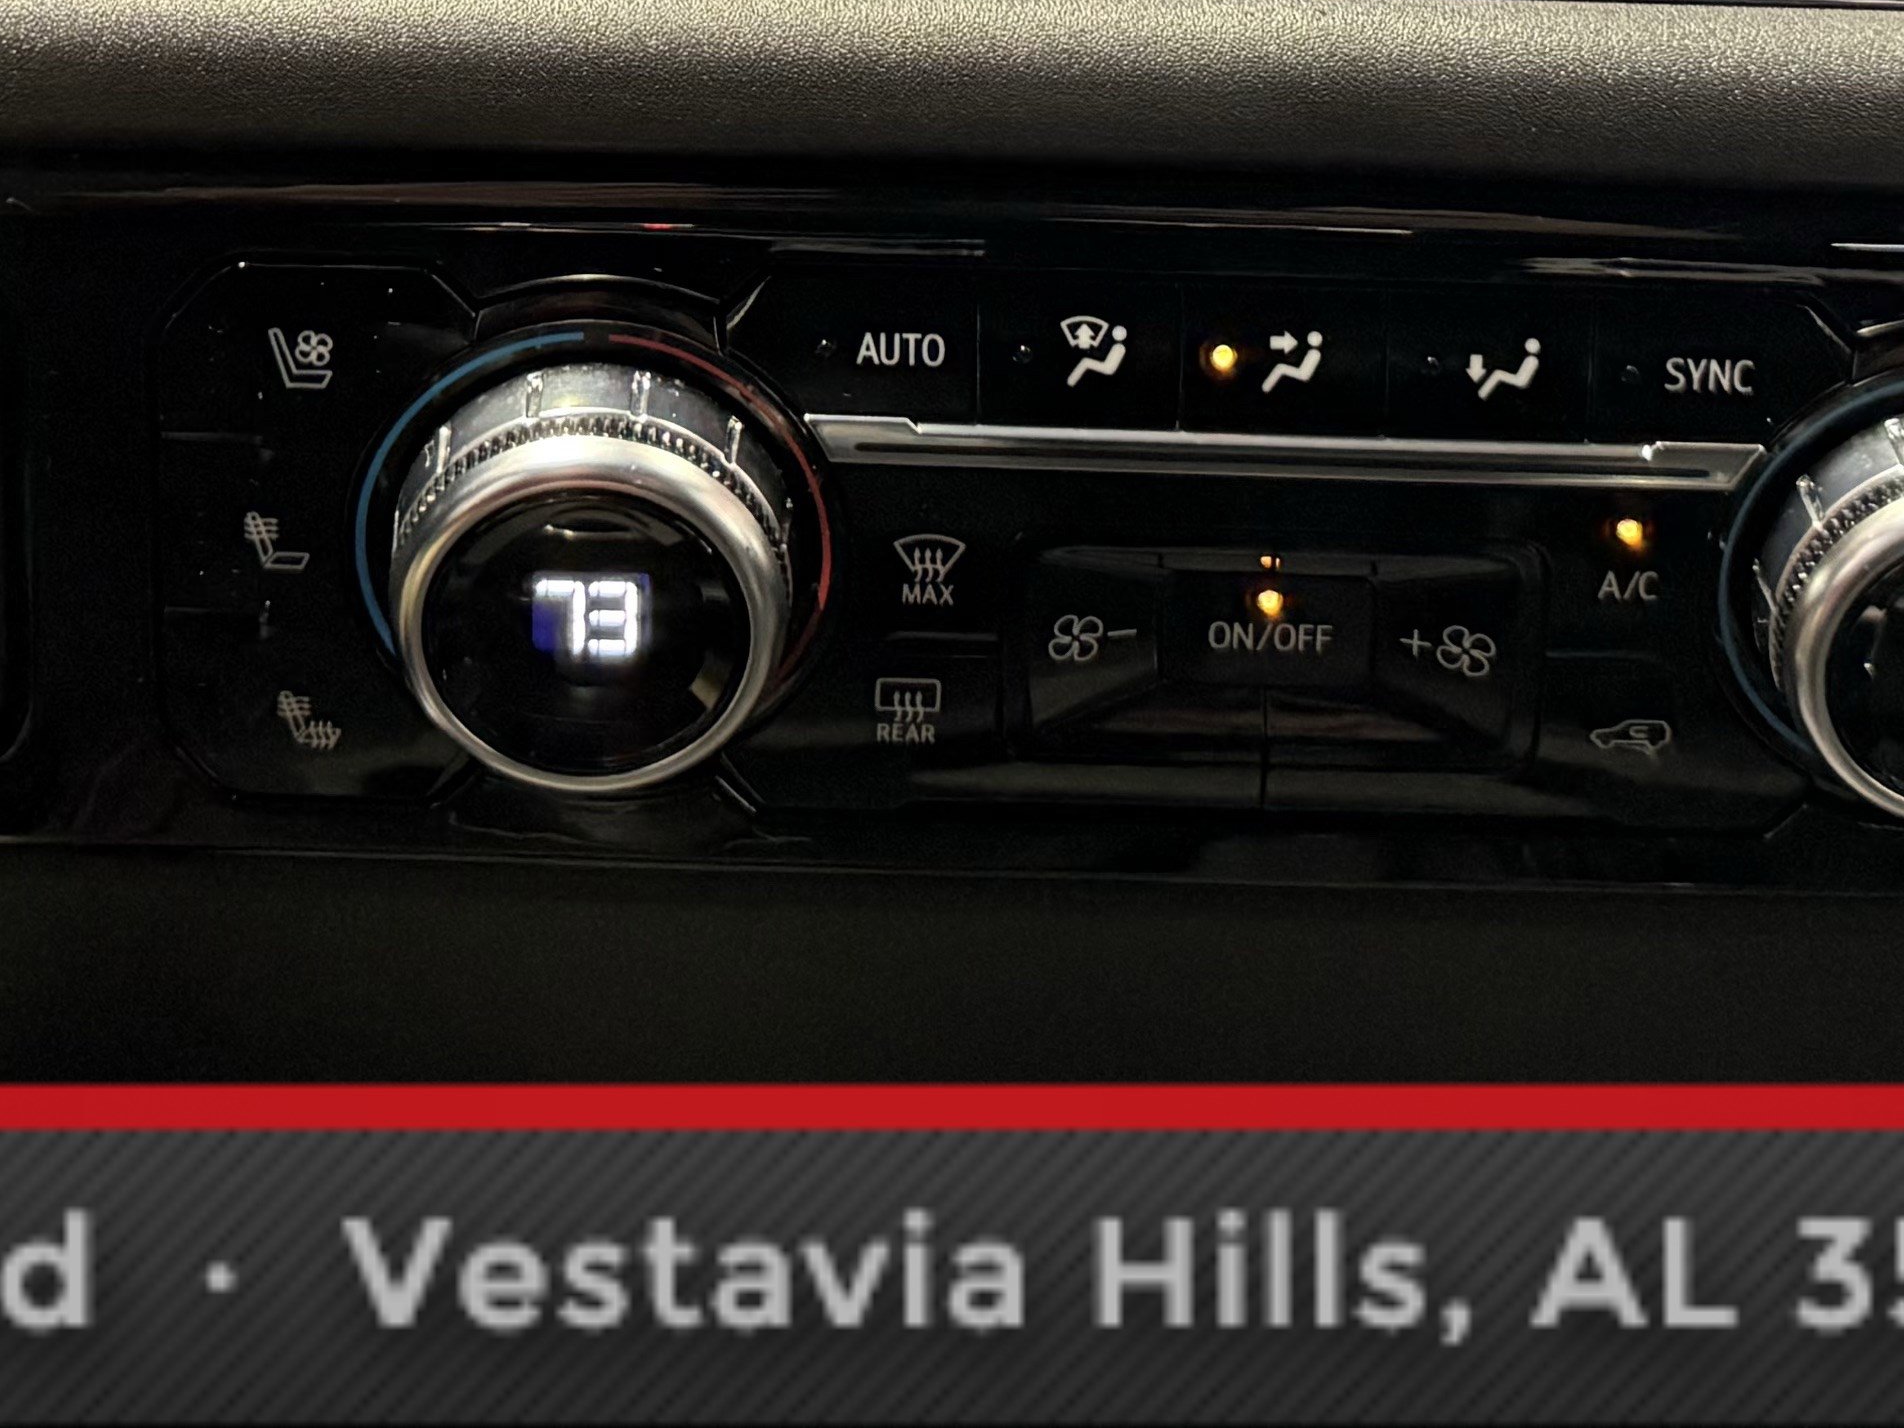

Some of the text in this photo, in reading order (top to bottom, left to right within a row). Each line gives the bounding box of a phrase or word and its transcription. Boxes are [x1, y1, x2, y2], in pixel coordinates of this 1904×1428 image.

[856, 332, 945, 367] AUTO
[1665, 357, 1754, 395] SYNC
[902, 580, 953, 605] MAX
[1598, 571, 1658, 601] A/C
[534, 578, 639, 658] 73
[1208, 618, 1332, 654] ON/OFF
[876, 718, 935, 743] REAR
